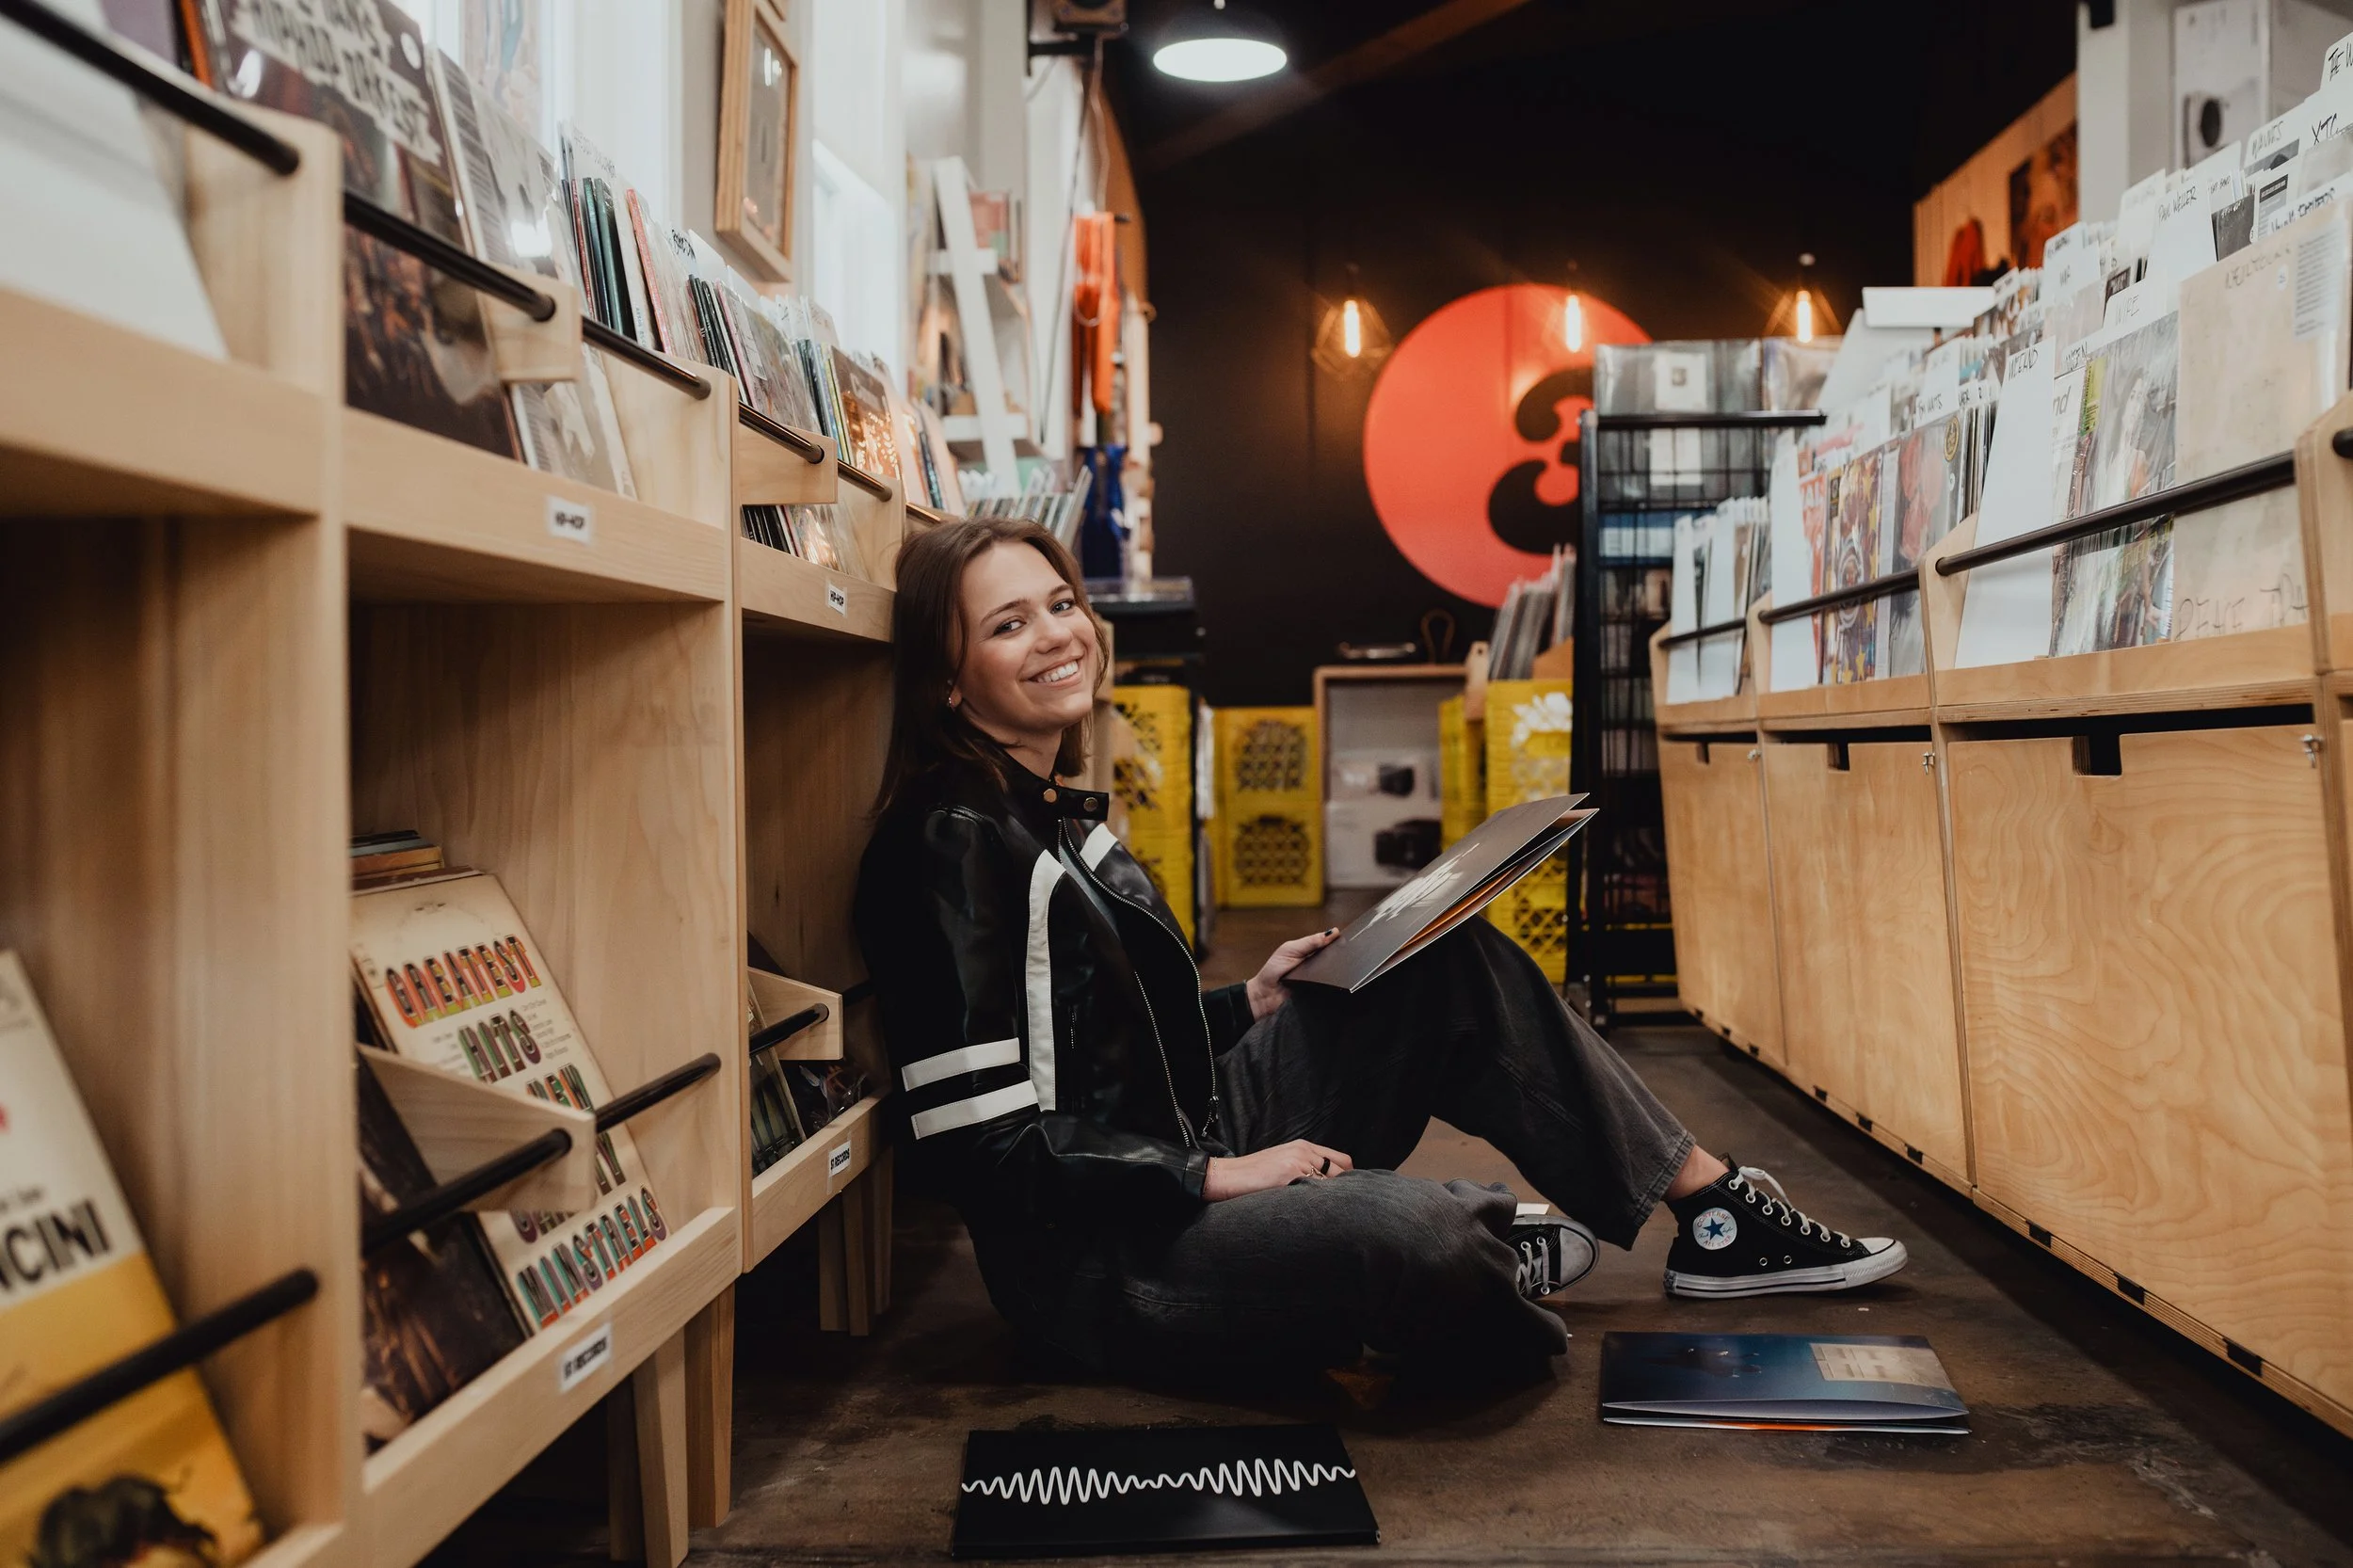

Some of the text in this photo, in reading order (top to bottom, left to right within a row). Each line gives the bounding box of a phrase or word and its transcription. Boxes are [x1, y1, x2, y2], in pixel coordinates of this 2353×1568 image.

[2312, 112, 2340, 145] XTC
[2172, 185, 2198, 214] WELLER
[385, 935, 542, 1029] GREATEST
[457, 1008, 541, 1084] HITS
[1697, 1210, 1730, 1228] CONVERSE
[515, 1183, 667, 1329] MINSTRELS
